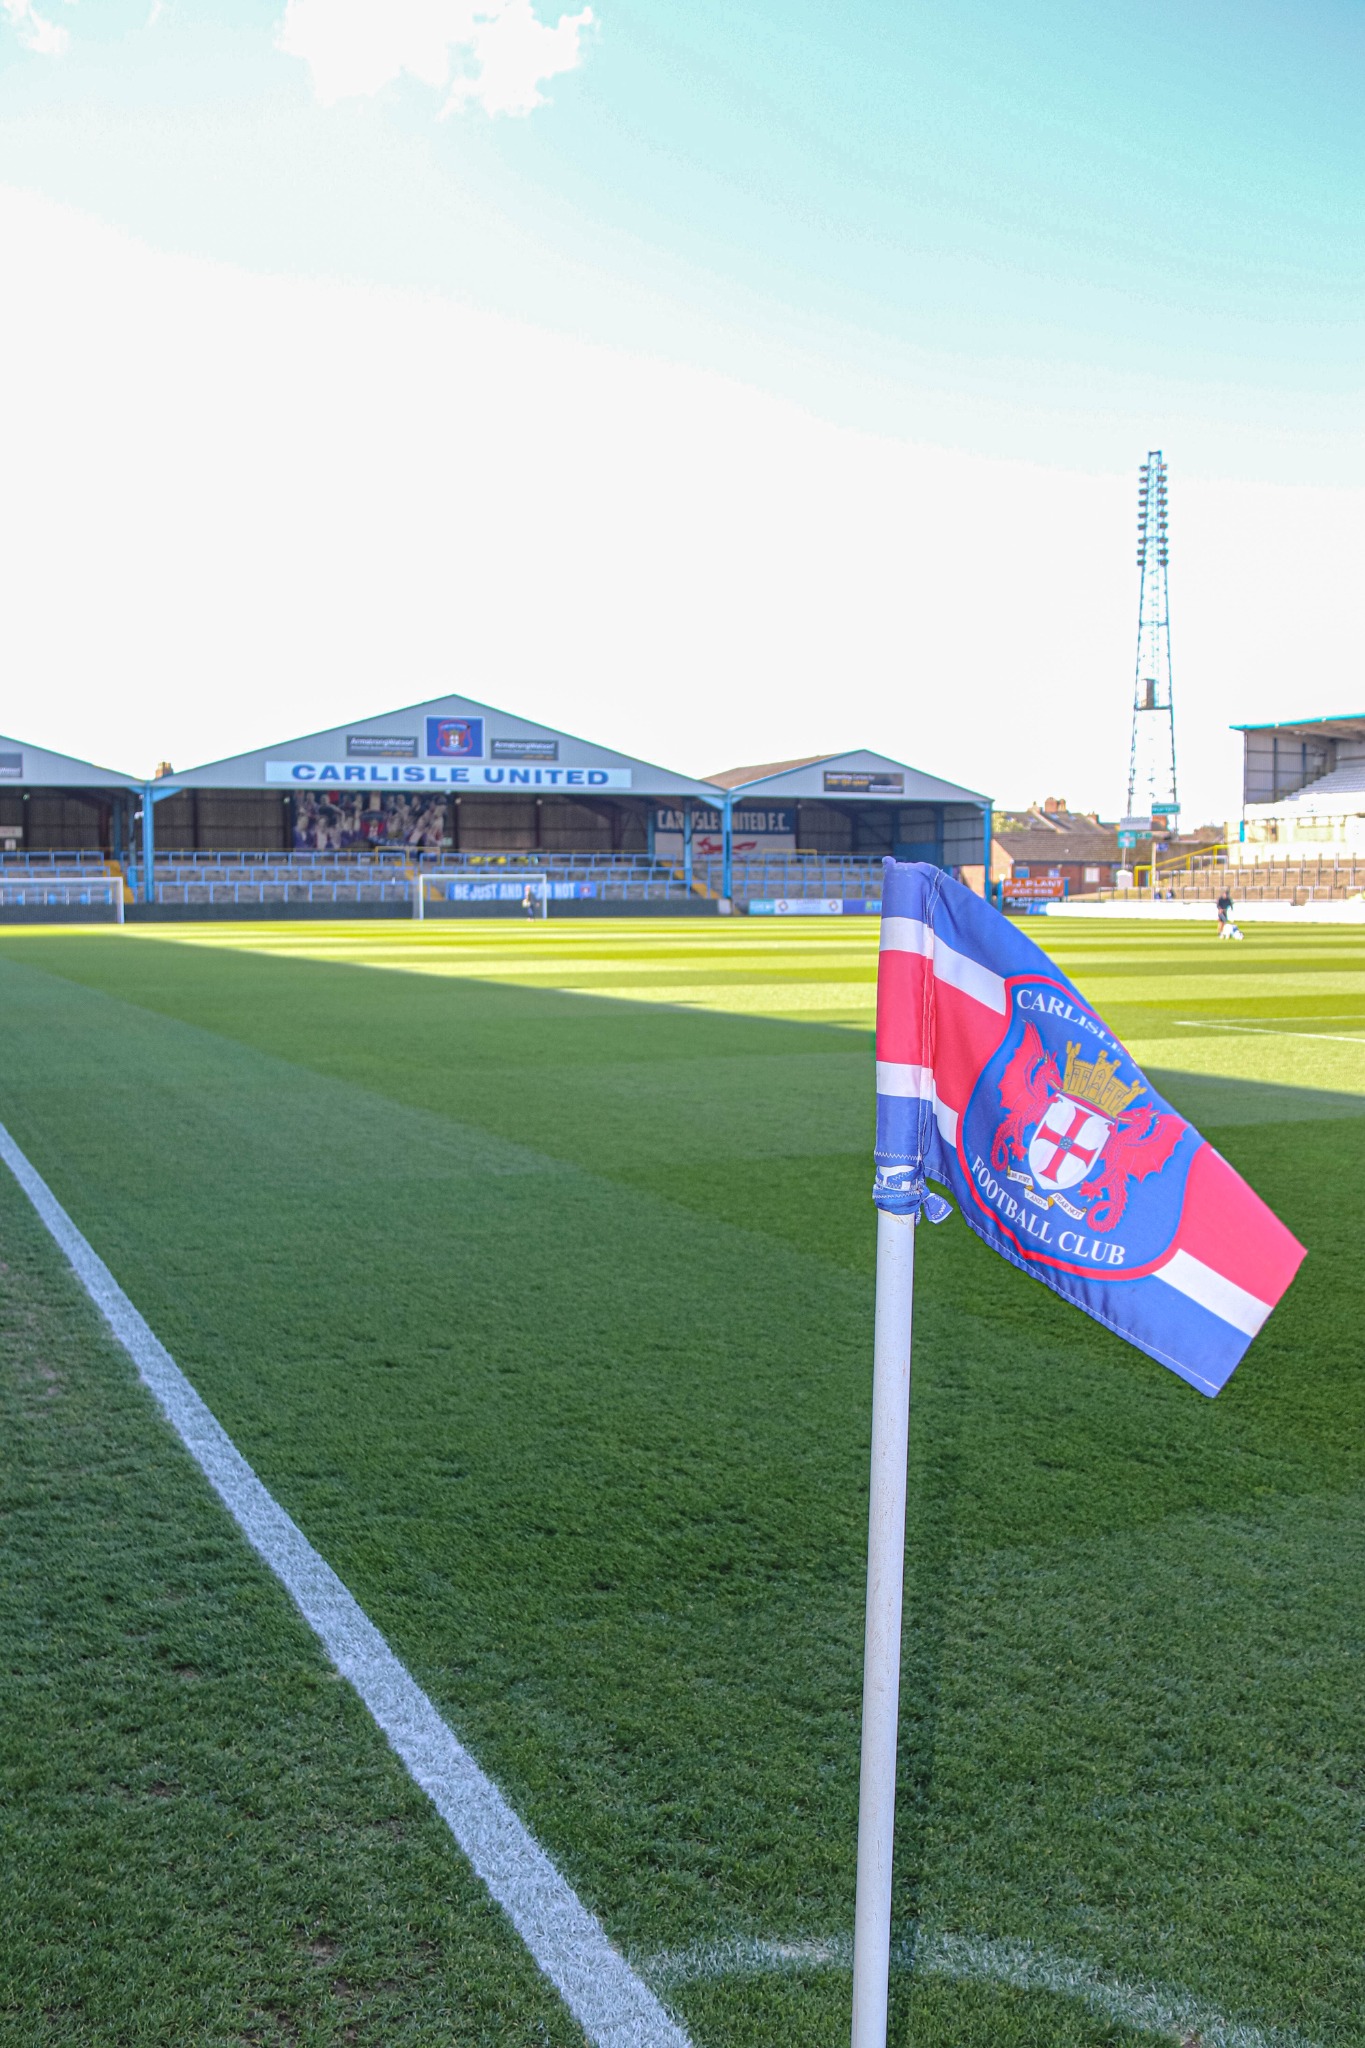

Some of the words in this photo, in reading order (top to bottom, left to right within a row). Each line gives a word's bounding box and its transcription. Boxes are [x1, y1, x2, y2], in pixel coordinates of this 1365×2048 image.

[291, 763, 470, 782] CARLISLE
[483, 768, 609, 785] UNITED
[657, 810, 718, 830] CARISLE
[720, 812, 767, 830] NITED
[454, 883, 469, 899] BE
[470, 883, 497, 899] JUST
[501, 883, 522, 899] AND
[555, 883, 576, 899] NOT
[971, 1155, 1053, 1244] FOOTBALL
[1058, 1231, 1126, 1265] CLUB
[1053, 1194, 1070, 1208] FEAR
[1067, 1206, 1083, 1218] NOT
